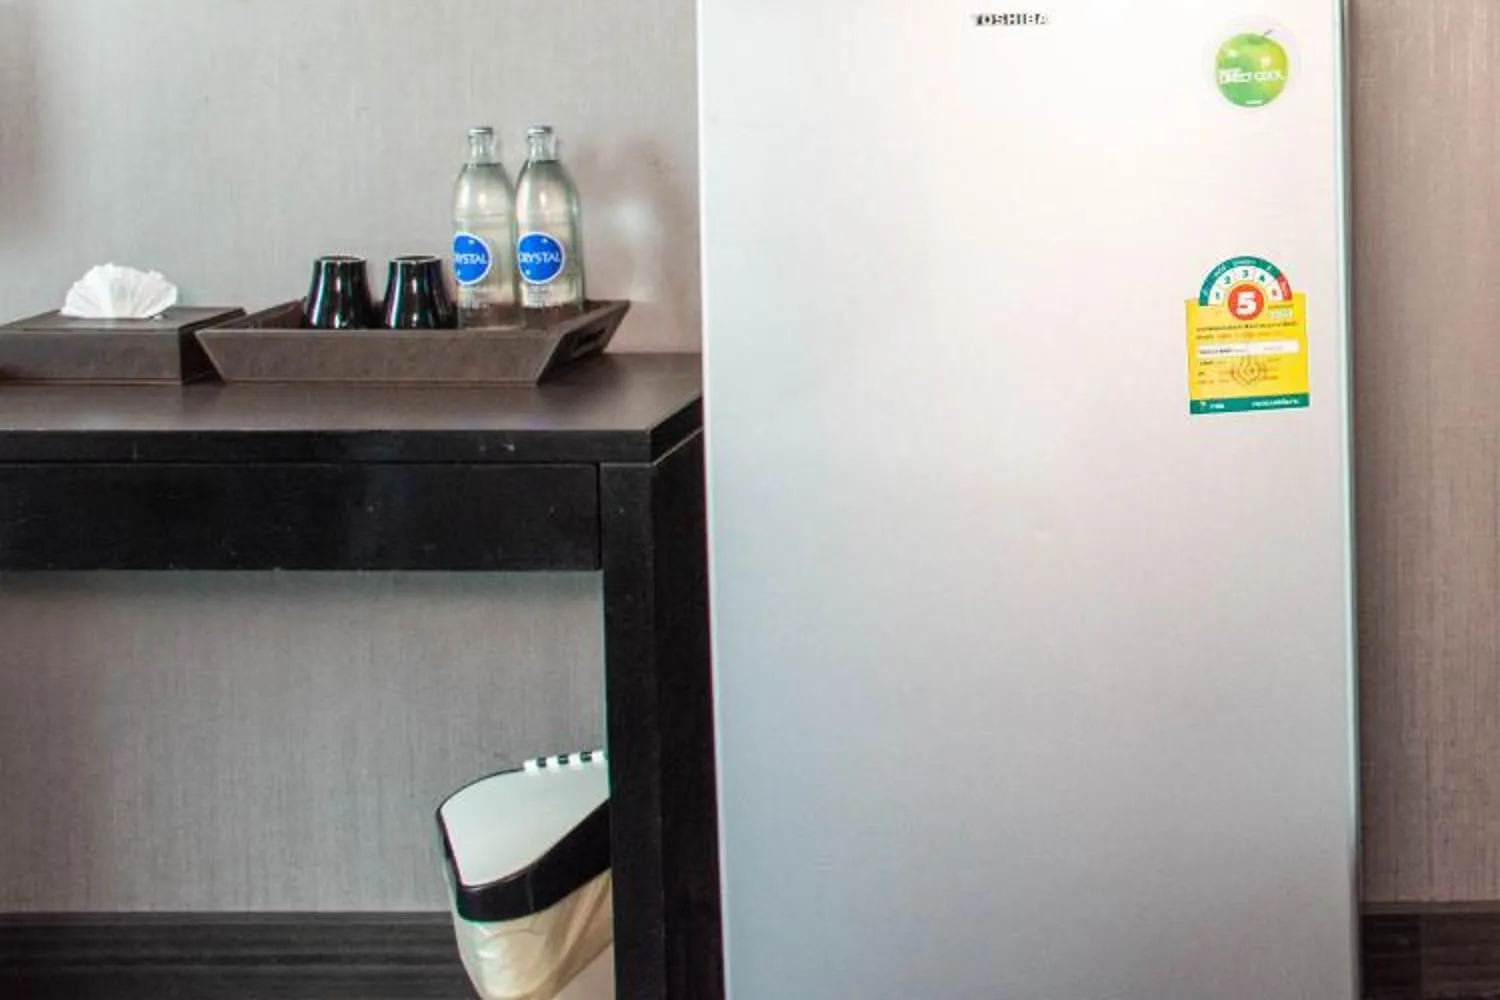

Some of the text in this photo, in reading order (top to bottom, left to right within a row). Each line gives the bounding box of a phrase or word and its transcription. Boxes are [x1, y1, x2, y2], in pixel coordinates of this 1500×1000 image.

[972, 13, 1050, 25] TOSHIBA
[454, 253, 487, 265] RYSTAL
[519, 251, 561, 264] CRYSTAL
[1241, 269, 1249, 279] 3
[1236, 290, 1258, 316] 5
